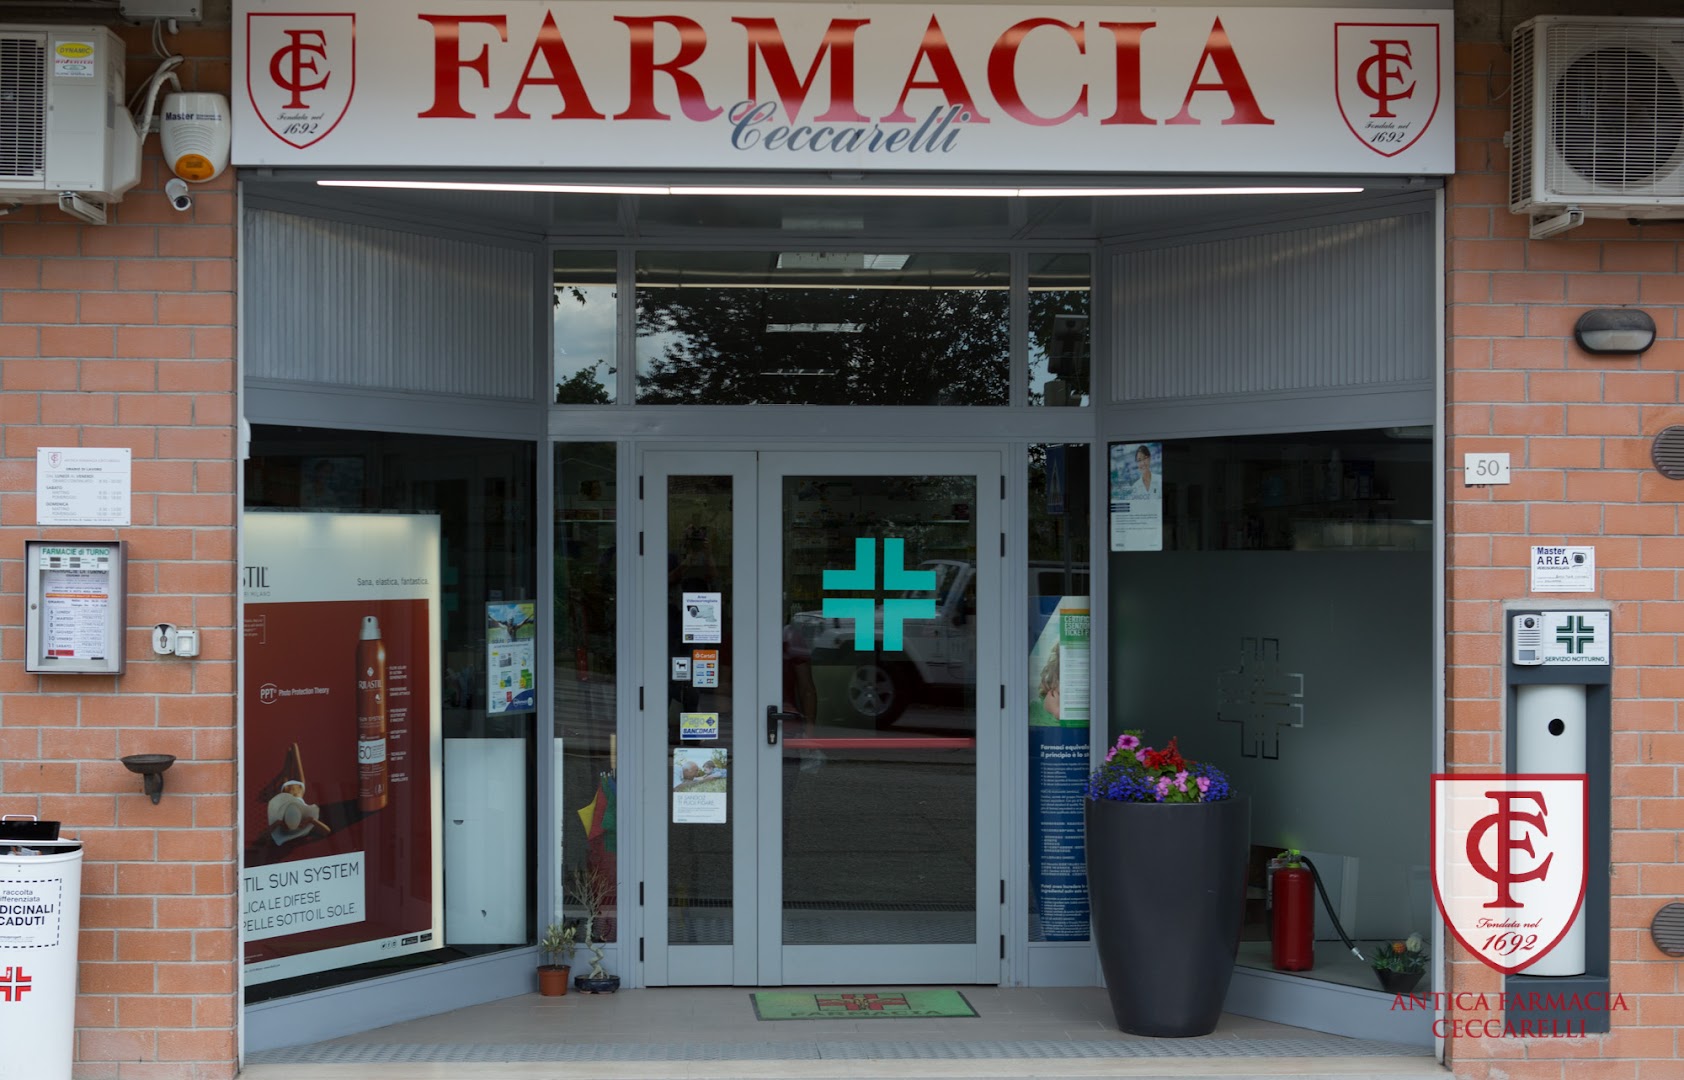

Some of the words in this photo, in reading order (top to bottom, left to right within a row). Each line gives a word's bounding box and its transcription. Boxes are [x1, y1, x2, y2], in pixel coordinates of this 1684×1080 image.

[418, 9, 1275, 127] FARMACIA
[165, 112, 195, 120] Master
[282, 122, 319, 135] 1692
[728, 100, 971, 154] Ceccarelli
[1364, 121, 1395, 129] Fondata
[1397, 121, 1412, 129] nel
[1370, 131, 1405, 143] 1692
[1475, 459, 1500, 476] 50
[1536, 547, 1566, 555] Master
[1537, 556, 1569, 565] AREA
[243, 566, 270, 588] TIL
[357, 577, 374, 587] Sana,
[375, 576, 399, 587] elastica,
[400, 576, 429, 586] fantastica.
[358, 680, 383, 689] RILASTIL
[291, 688, 314, 696] Protection
[314, 687, 330, 695] Theory
[359, 745, 372, 760] 50
[269, 871, 299, 889] SUN
[303, 862, 359, 884] SYSTEM
[268, 897, 281, 910] LE
[284, 891, 321, 907] DIFESE
[276, 910, 315, 927] SOTTO
[316, 909, 325, 920] IL
